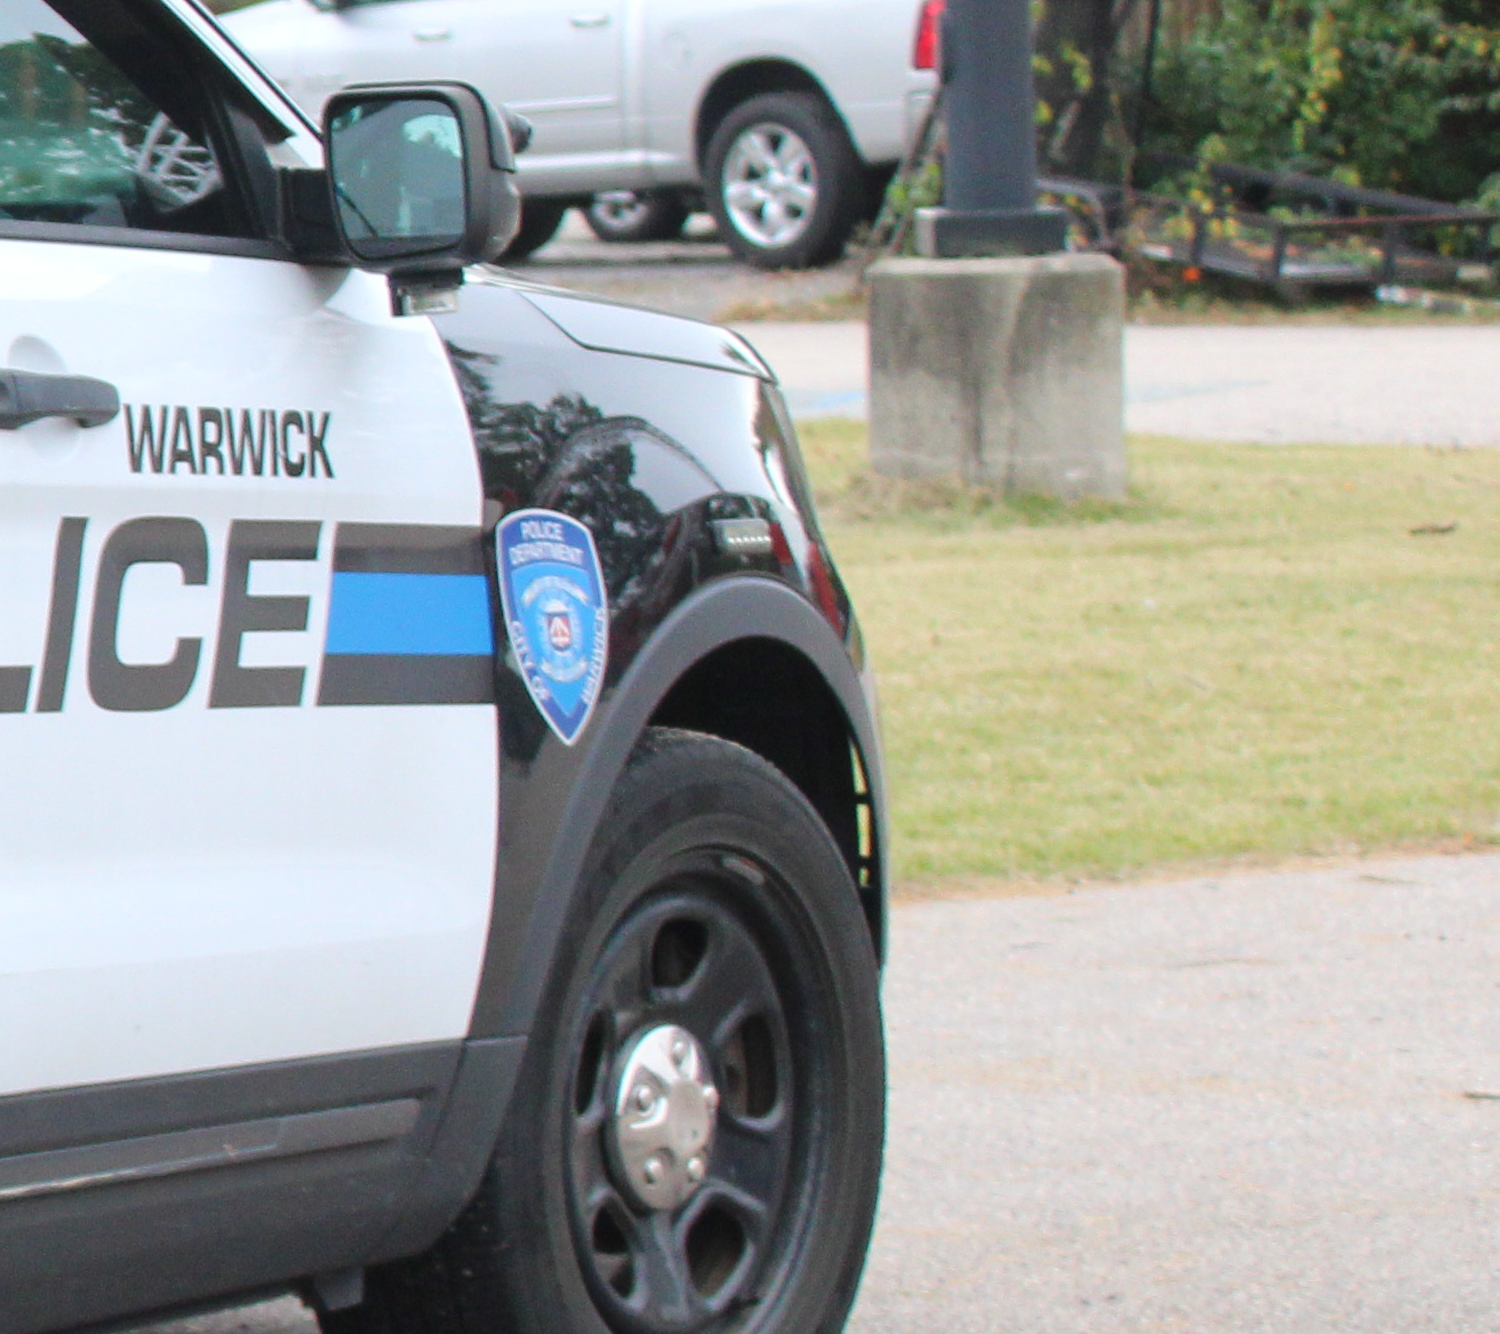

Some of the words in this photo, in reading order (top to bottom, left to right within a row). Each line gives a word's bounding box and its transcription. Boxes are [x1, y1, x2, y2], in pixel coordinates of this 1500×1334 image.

[124, 404, 336, 479] WARWICK
[520, 520, 566, 542] POLICE
[508, 540, 586, 567] DEPARTMENT
